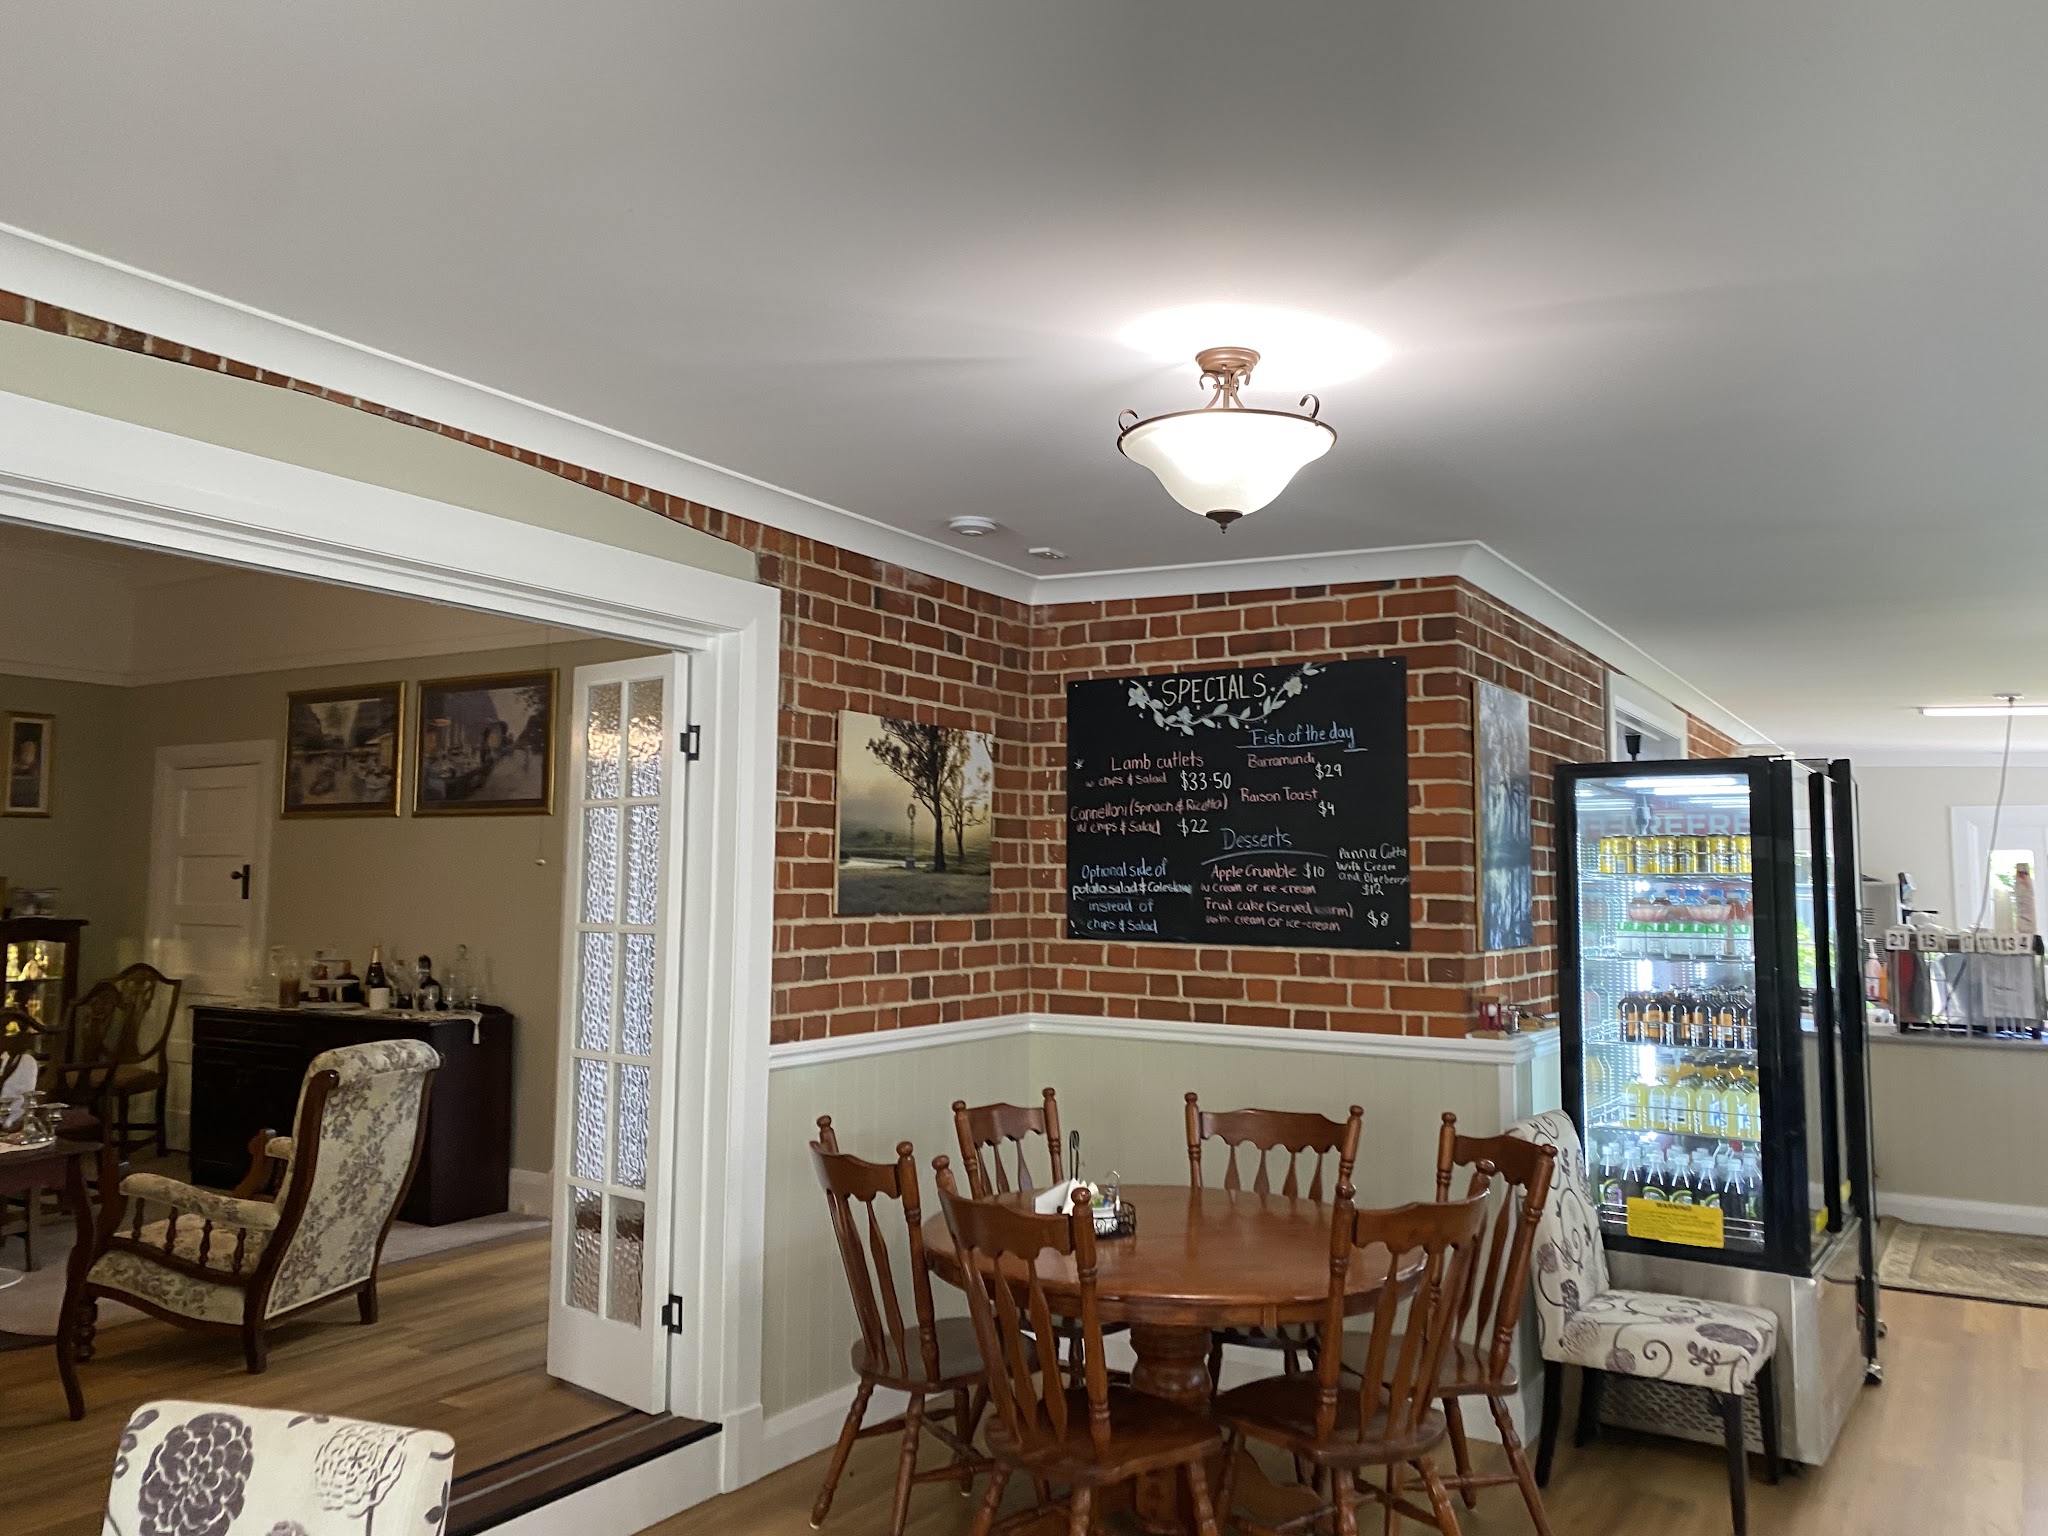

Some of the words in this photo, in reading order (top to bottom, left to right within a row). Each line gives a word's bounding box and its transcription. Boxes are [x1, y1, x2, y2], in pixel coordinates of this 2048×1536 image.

[1162, 673, 1266, 706] SPECIALS
[1250, 728, 1285, 746] Fish
[1288, 724, 1302, 742] of
[1305, 724, 1325, 741] the
[1329, 721, 1354, 749] day
[1111, 753, 1150, 771] Lamb
[1157, 751, 1204, 769] cutlets
[1248, 752, 1315, 768] Barramundi
[1314, 761, 1342, 780] $29
[1283, 786, 1318, 801] Toast
[1070, 801, 1127, 821] Cannelloni
[1318, 800, 1335, 817] $4
[1177, 817, 1209, 837] $22
[1220, 826, 1293, 850] Desserts
[1339, 847, 1377, 859] Panna
[1081, 861, 1127, 883] Optional
[1130, 857, 1152, 876] side
[1155, 857, 1168, 877] of
[1211, 864, 1243, 882] Apple
[1302, 862, 1325, 879] $10
[1338, 872, 1361, 882] and
[1072, 882, 1107, 900] potato
[1109, 880, 1138, 895] salad
[1246, 884, 1258, 892] or
[1361, 883, 1384, 895] $12
[1089, 899, 1133, 912] instead
[1139, 899, 1154, 912] of
[1204, 897, 1232, 911] Fruit
[1237, 899, 1264, 912] cake
[1268, 918, 1284, 927] or
[1367, 909, 1389, 928] $8
[1888, 934, 1905, 947] 21
